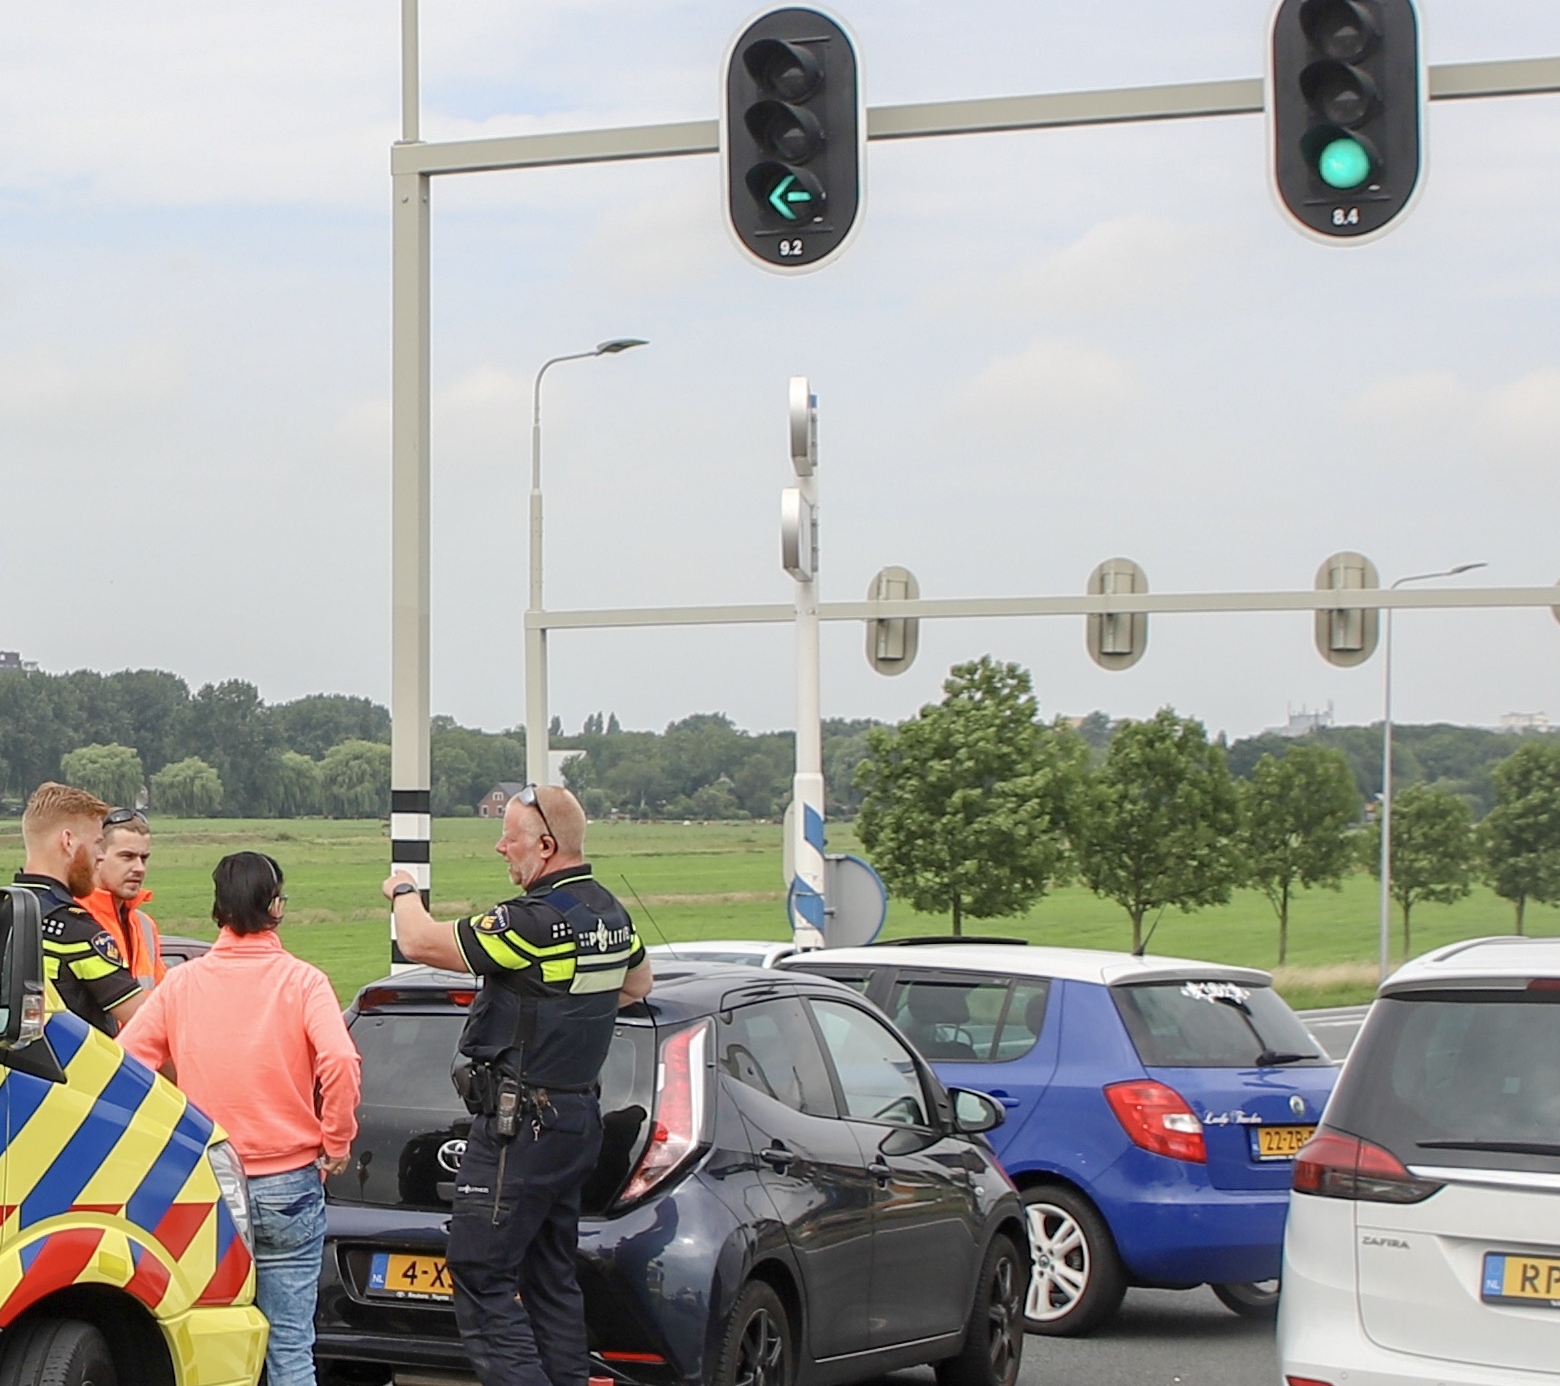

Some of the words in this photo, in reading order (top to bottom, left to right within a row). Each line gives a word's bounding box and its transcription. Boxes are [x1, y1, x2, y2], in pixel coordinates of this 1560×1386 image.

[1332, 207, 1359, 226] 8.4
[780, 239, 803, 256] 9.2
[1265, 1129, 1316, 1151] 22-ZB-
[1362, 1236, 1410, 1250] ZAFIRA
[402, 1260, 454, 1289] 4-X
[1486, 1279, 1501, 1290] NL
